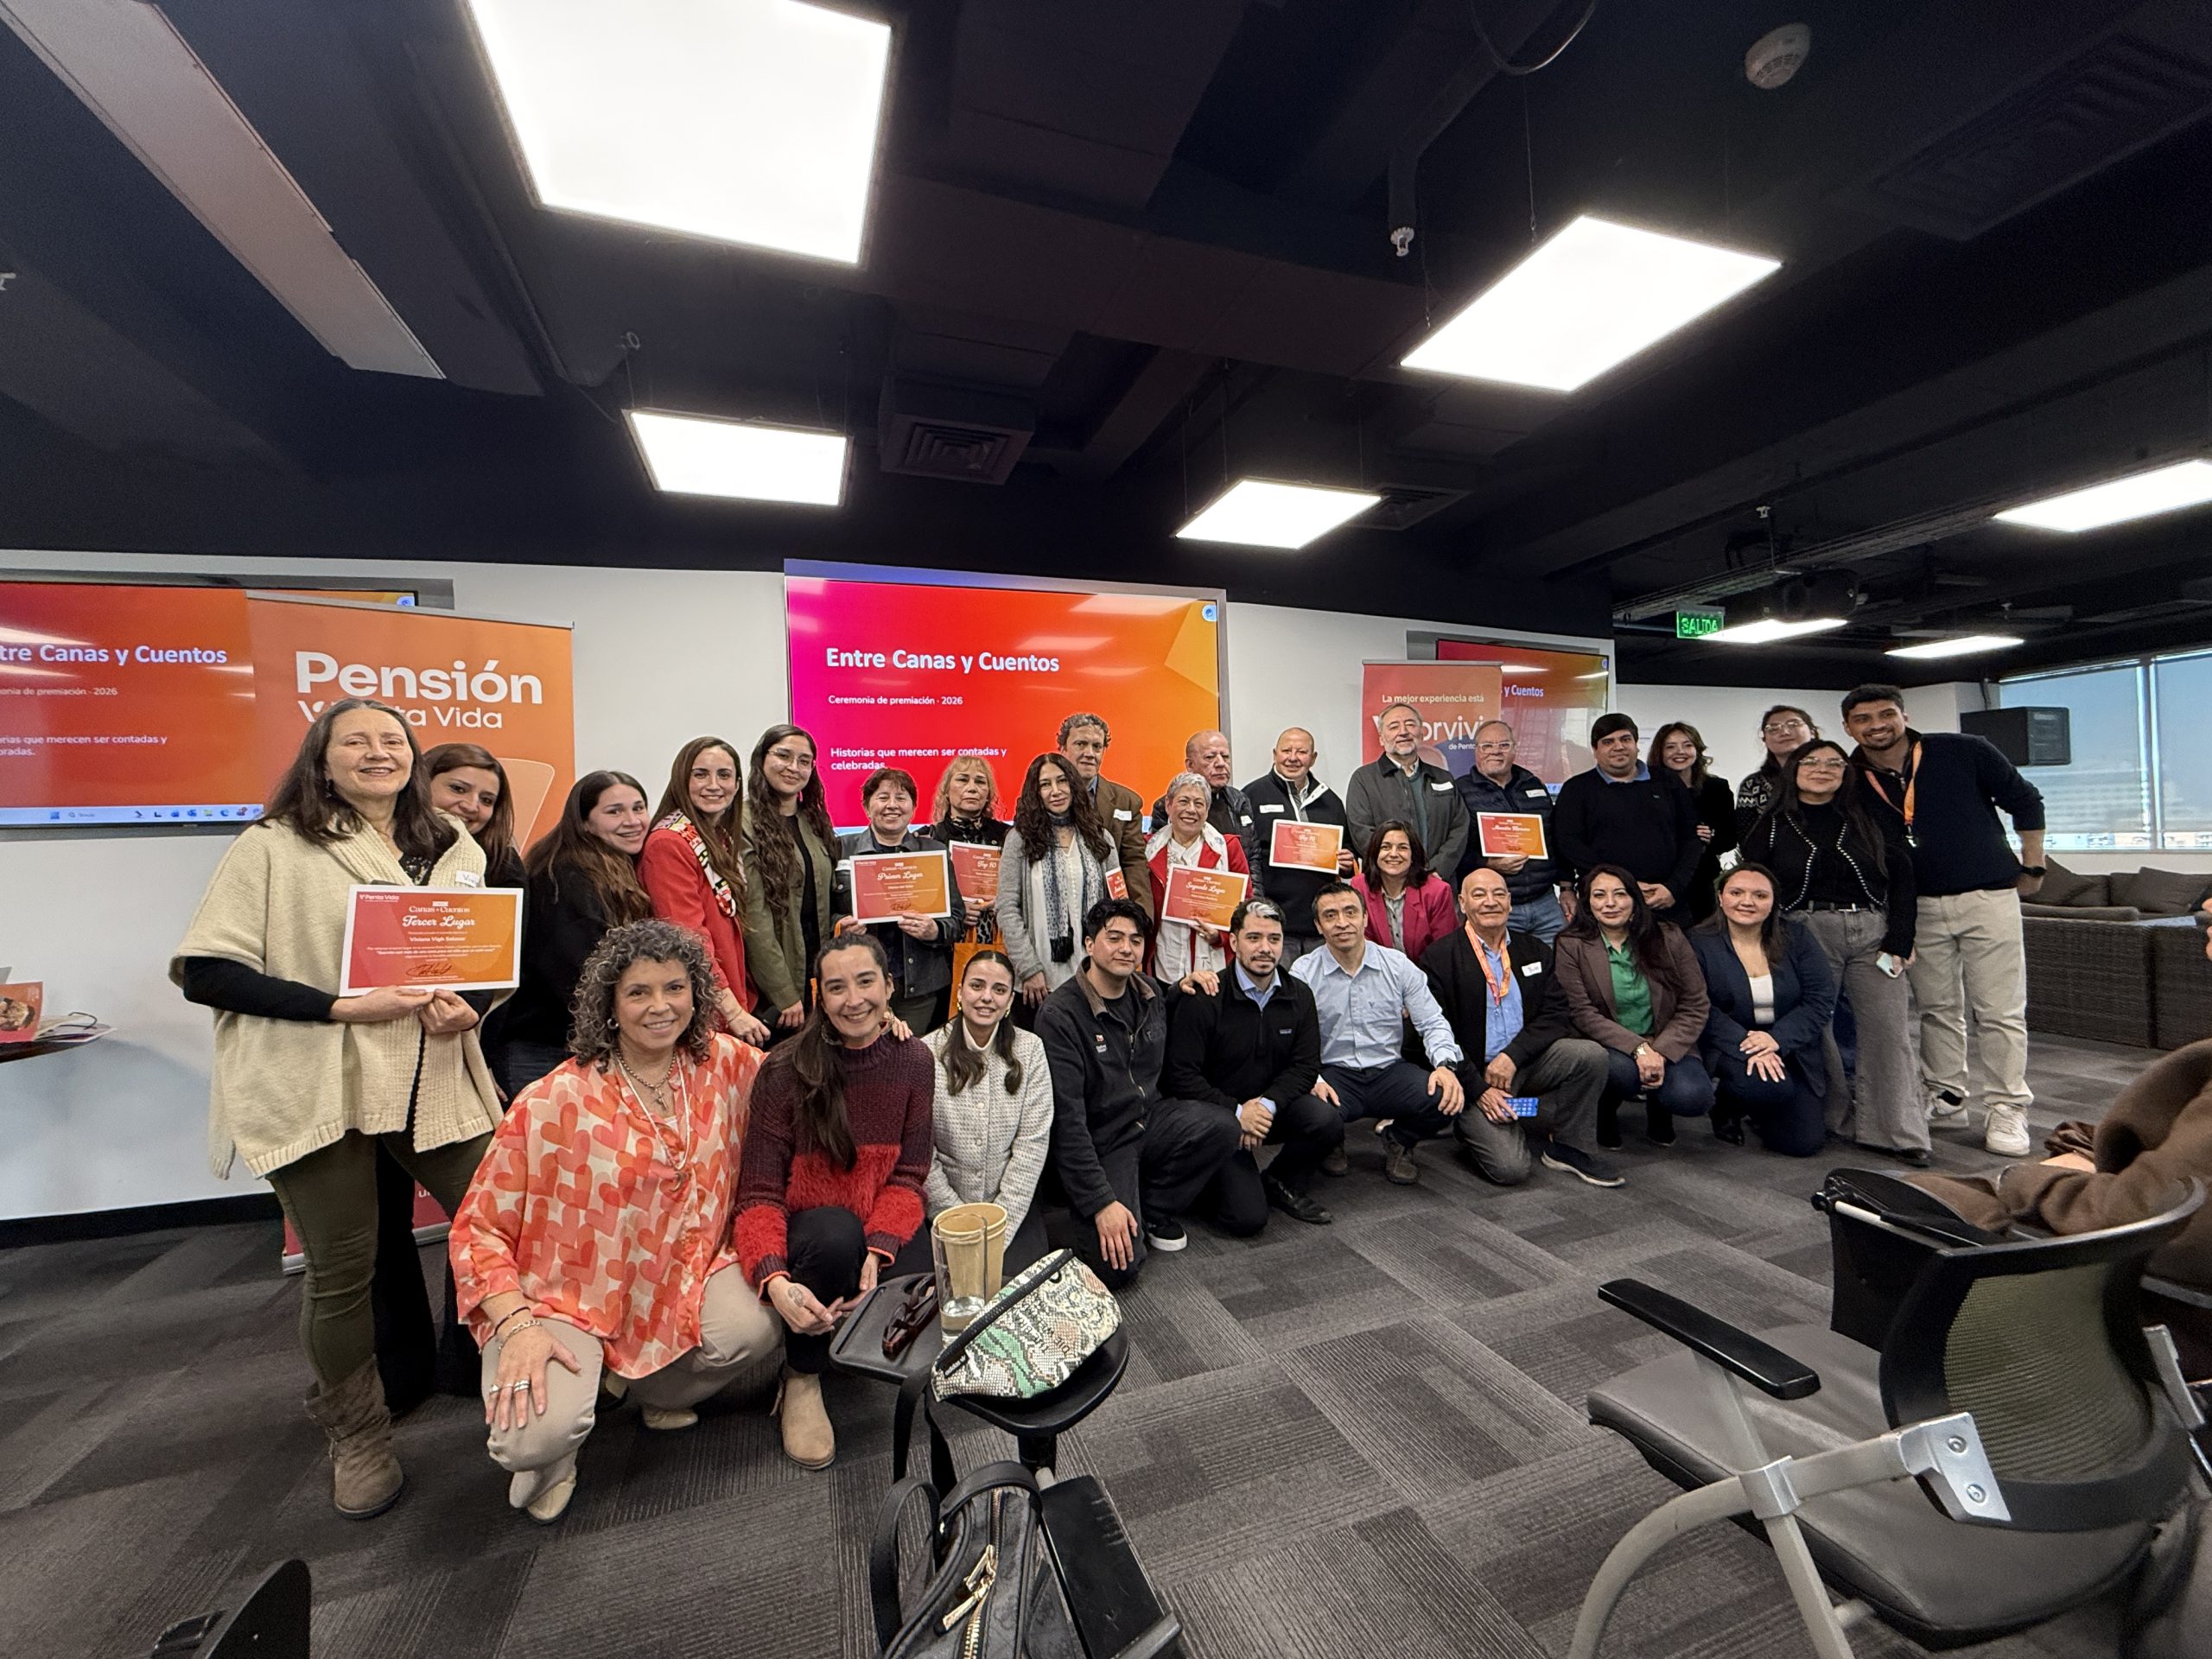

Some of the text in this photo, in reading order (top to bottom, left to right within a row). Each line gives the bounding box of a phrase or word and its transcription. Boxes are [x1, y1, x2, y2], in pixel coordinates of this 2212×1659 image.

[1681, 618, 1719, 634] SALIDA
[0, 644, 227, 666] tre Canas y Cuentos
[826, 647, 1059, 674] Entre Canas y Cuentos
[296, 651, 543, 704] Pensión
[1503, 684, 1544, 697] y Cuentos
[828, 695, 963, 706] Ceremonia de premiación 2026
[1382, 694, 1484, 704] La mejor experiencia está
[432, 706, 503, 728] Vida
[24, 736, 44, 745] que
[112, 734, 159, 745] contadas
[161, 736, 168, 745] y
[830, 747, 874, 758] Historias
[877, 748, 896, 759] que
[898, 748, 939, 757] merecen
[957, 747, 999, 756] contadas
[1001, 748, 1007, 757] y
[402, 915, 475, 930] Tercer Lugar
